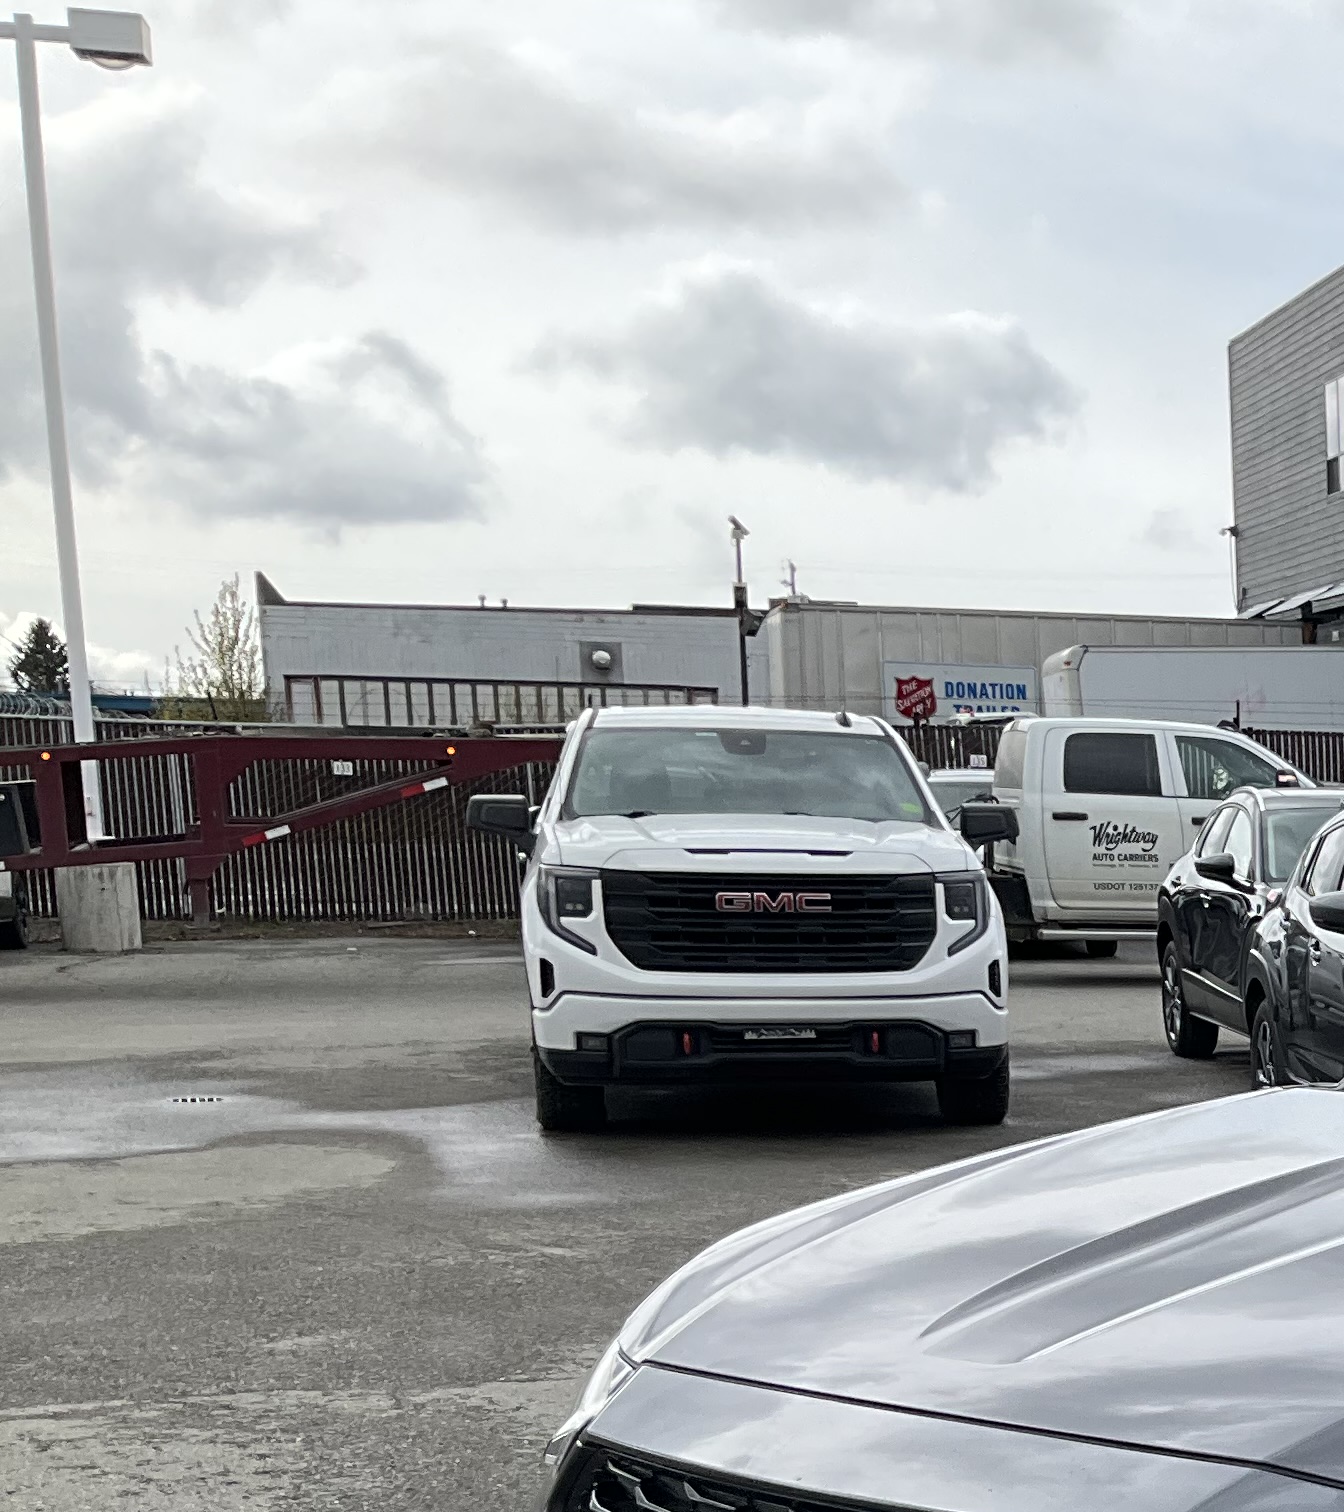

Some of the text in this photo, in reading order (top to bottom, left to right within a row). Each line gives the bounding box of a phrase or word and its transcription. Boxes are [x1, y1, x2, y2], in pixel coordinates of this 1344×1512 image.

[901, 679, 918, 695] THE
[944, 681, 1027, 700] DONATION
[1089, 821, 1159, 852] Wrightway
[1092, 853, 1159, 863] AUTO CARRIERS
[1093, 883, 1125, 891] USDOT
[715, 892, 833, 913] GMC
